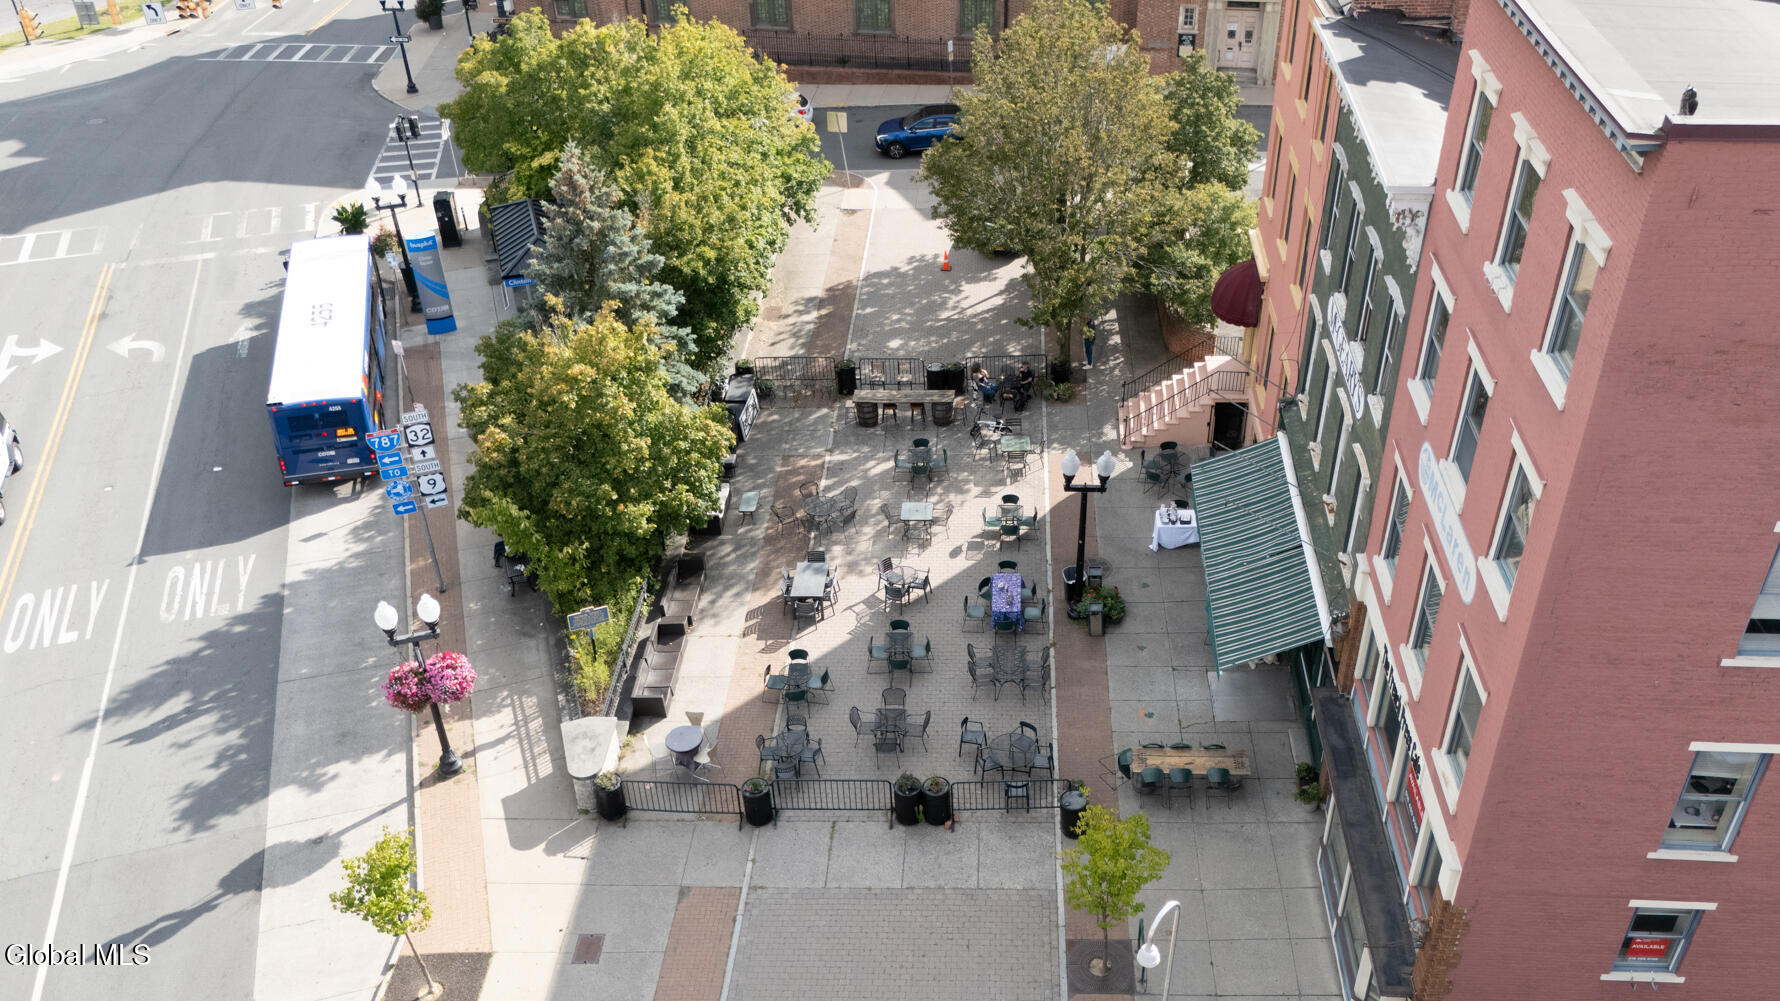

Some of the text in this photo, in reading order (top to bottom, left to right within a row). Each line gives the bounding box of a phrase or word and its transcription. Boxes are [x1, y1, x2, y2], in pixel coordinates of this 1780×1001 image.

[402, 412, 428, 423] SOUTH
[370, 434, 399, 449] 787
[408, 428, 432, 443] 32
[388, 469, 400, 477] TO
[416, 461, 440, 473] SOUTH
[427, 478, 437, 490] 9
[161, 554, 256, 623] ONLY
[4, 578, 110, 653] ONLY
